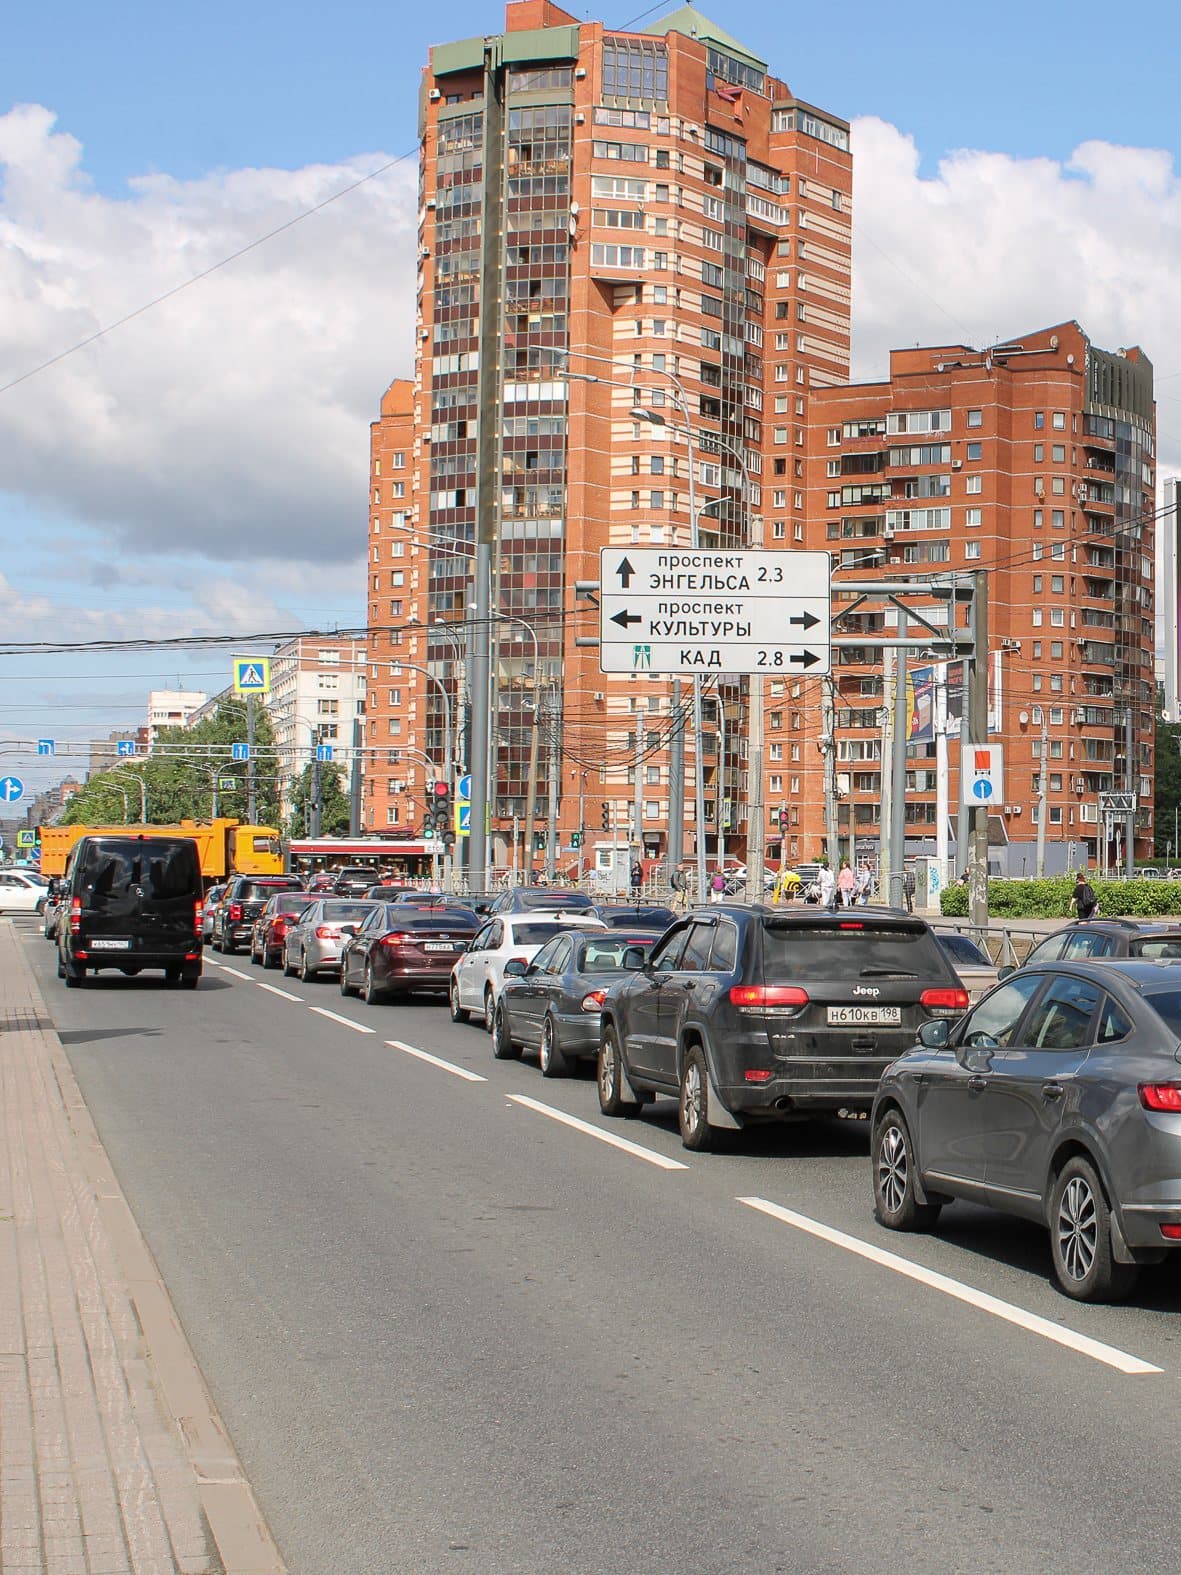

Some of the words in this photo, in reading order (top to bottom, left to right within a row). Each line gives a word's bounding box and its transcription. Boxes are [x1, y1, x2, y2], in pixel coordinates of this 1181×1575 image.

[658, 556, 743, 571] проспект
[649, 574, 750, 591] ЭНГЕЛЬСА
[757, 567, 784, 583] 2.3
[658, 602, 743, 617] проспект
[649, 620, 751, 637] КУЛЬТУРЫ
[680, 650, 722, 667] КАД
[757, 651, 784, 666] 2.8
[852, 985, 880, 997] Jeep
[831, 1008, 878, 1021] Н610КВ
[880, 1007, 898, 1018] 198
